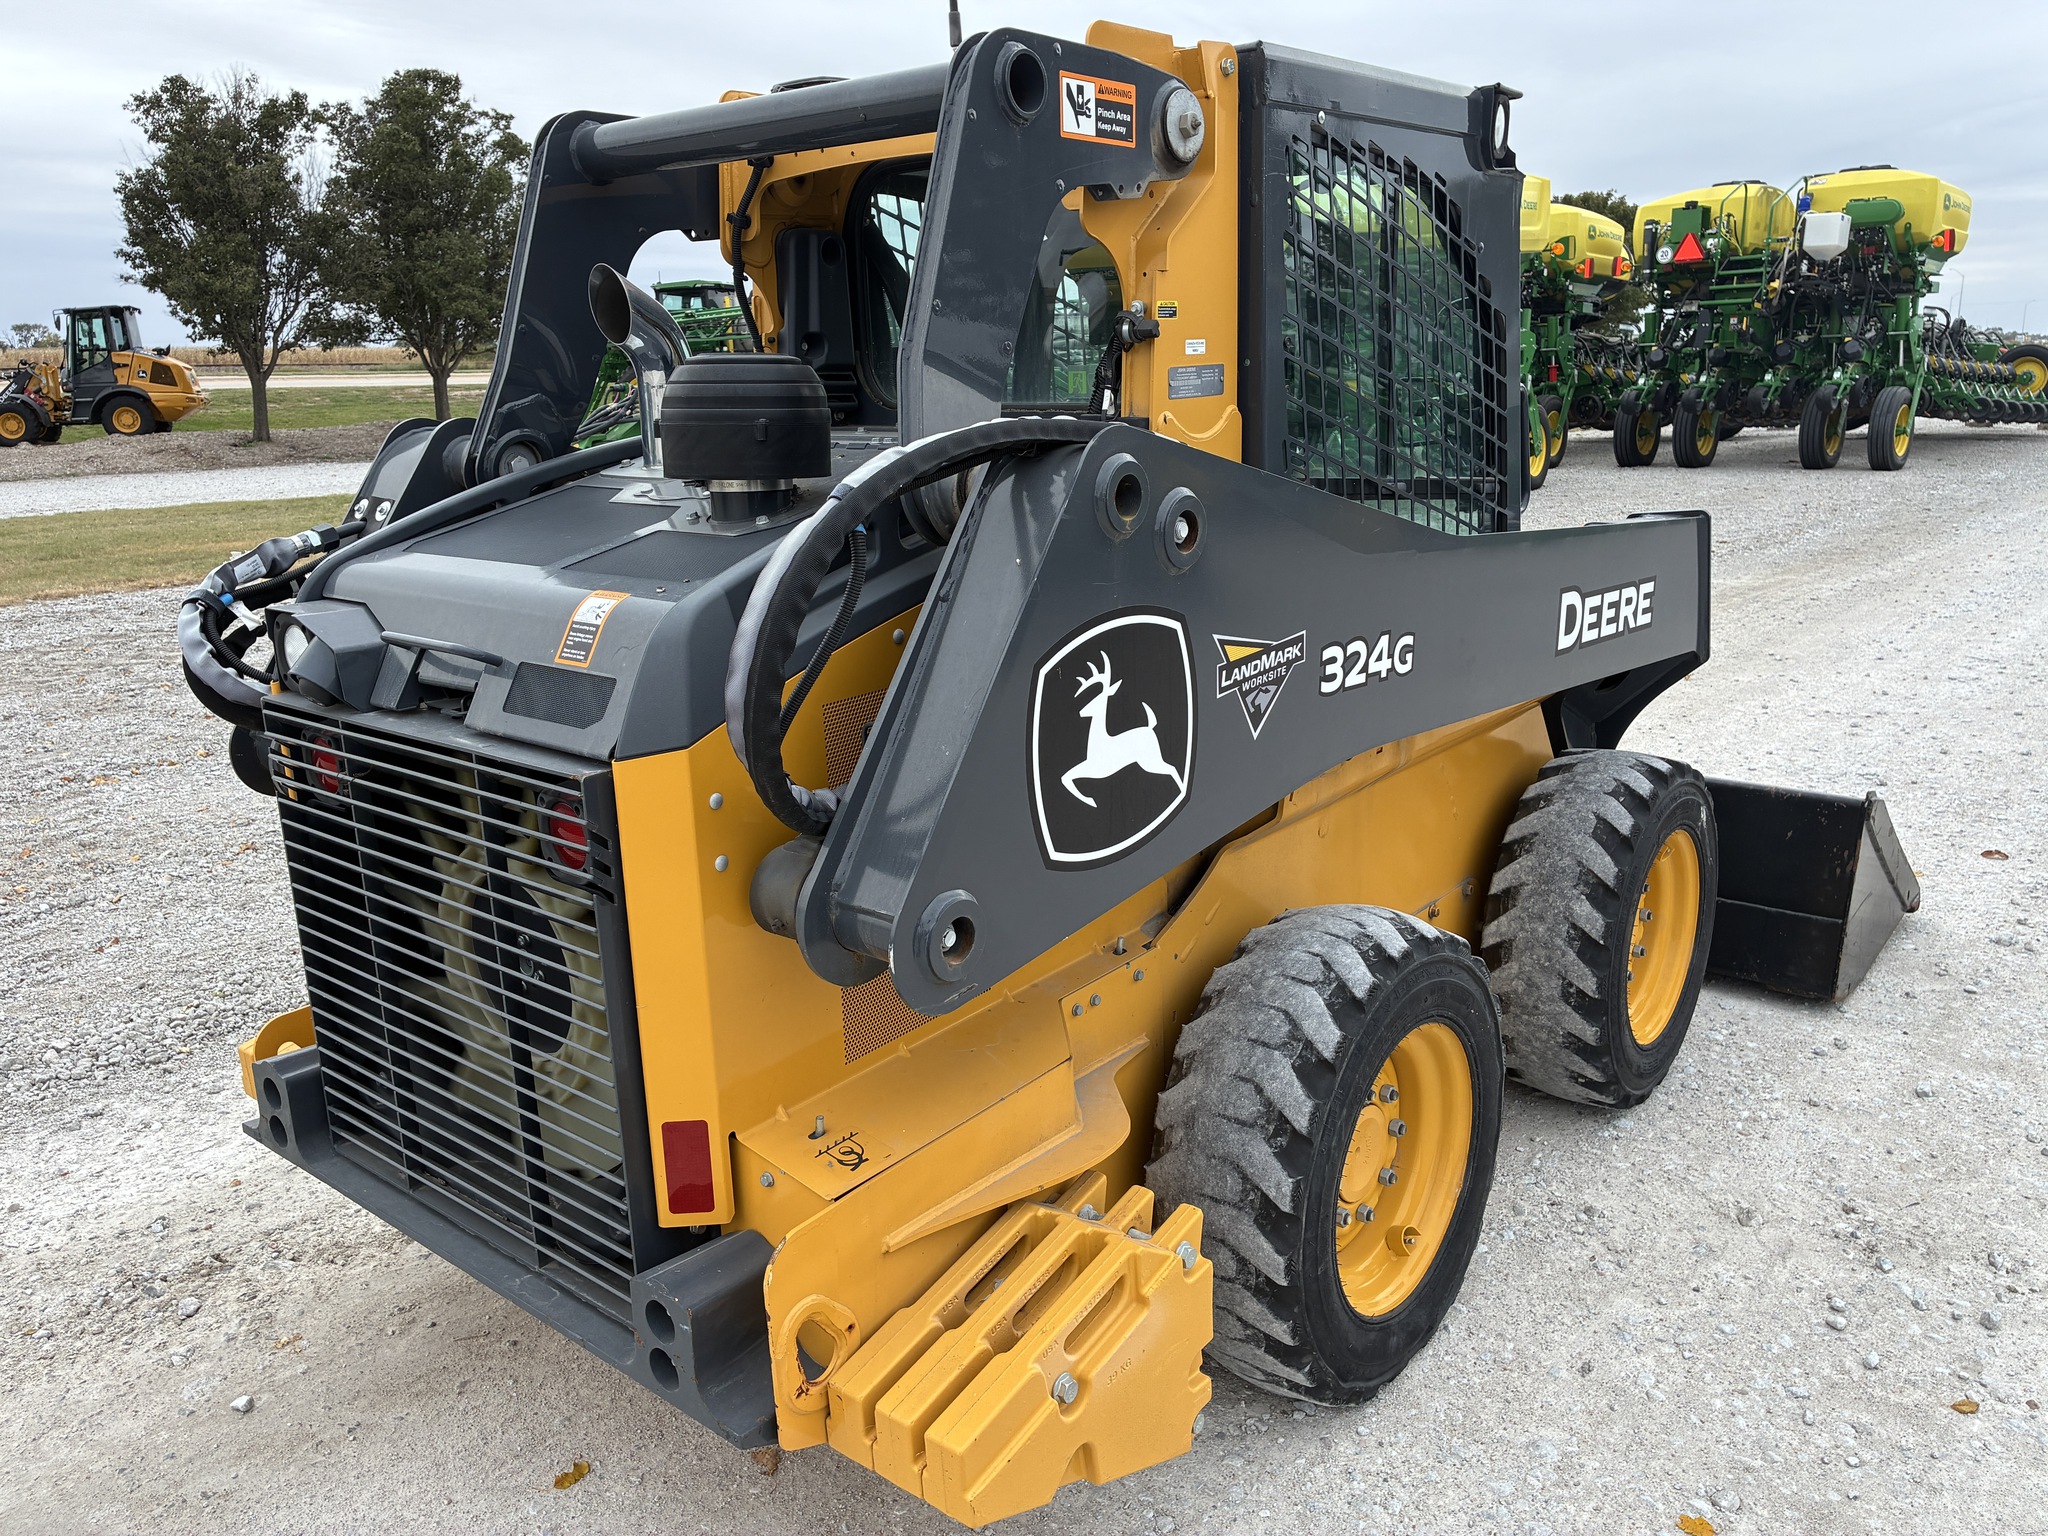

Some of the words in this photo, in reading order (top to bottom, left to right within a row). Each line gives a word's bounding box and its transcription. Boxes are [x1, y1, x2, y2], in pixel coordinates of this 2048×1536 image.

[1103, 84, 1132, 99] WARNING
[1097, 107, 1116, 118] Pinch
[1116, 110, 1131, 122] Area
[1097, 121, 1111, 132] Keep
[1112, 125, 1127, 135] Away
[1597, 229, 1610, 239] JOHN
[1660, 250, 1669, 258] 20
[0, 382, 17, 402] DEERE
[1557, 580, 1655, 651] DEERE
[1220, 642, 1303, 688] LANDMARK
[1319, 633, 1415, 695] 324G
[1241, 667, 1287, 692] WORKSITE
[942, 1295, 959, 1315] USA
[990, 1316, 1008, 1336] USA
[1042, 1340, 1059, 1360] USA
[1106, 1370, 1118, 1388] 39
[1119, 1357, 1133, 1375] KG
